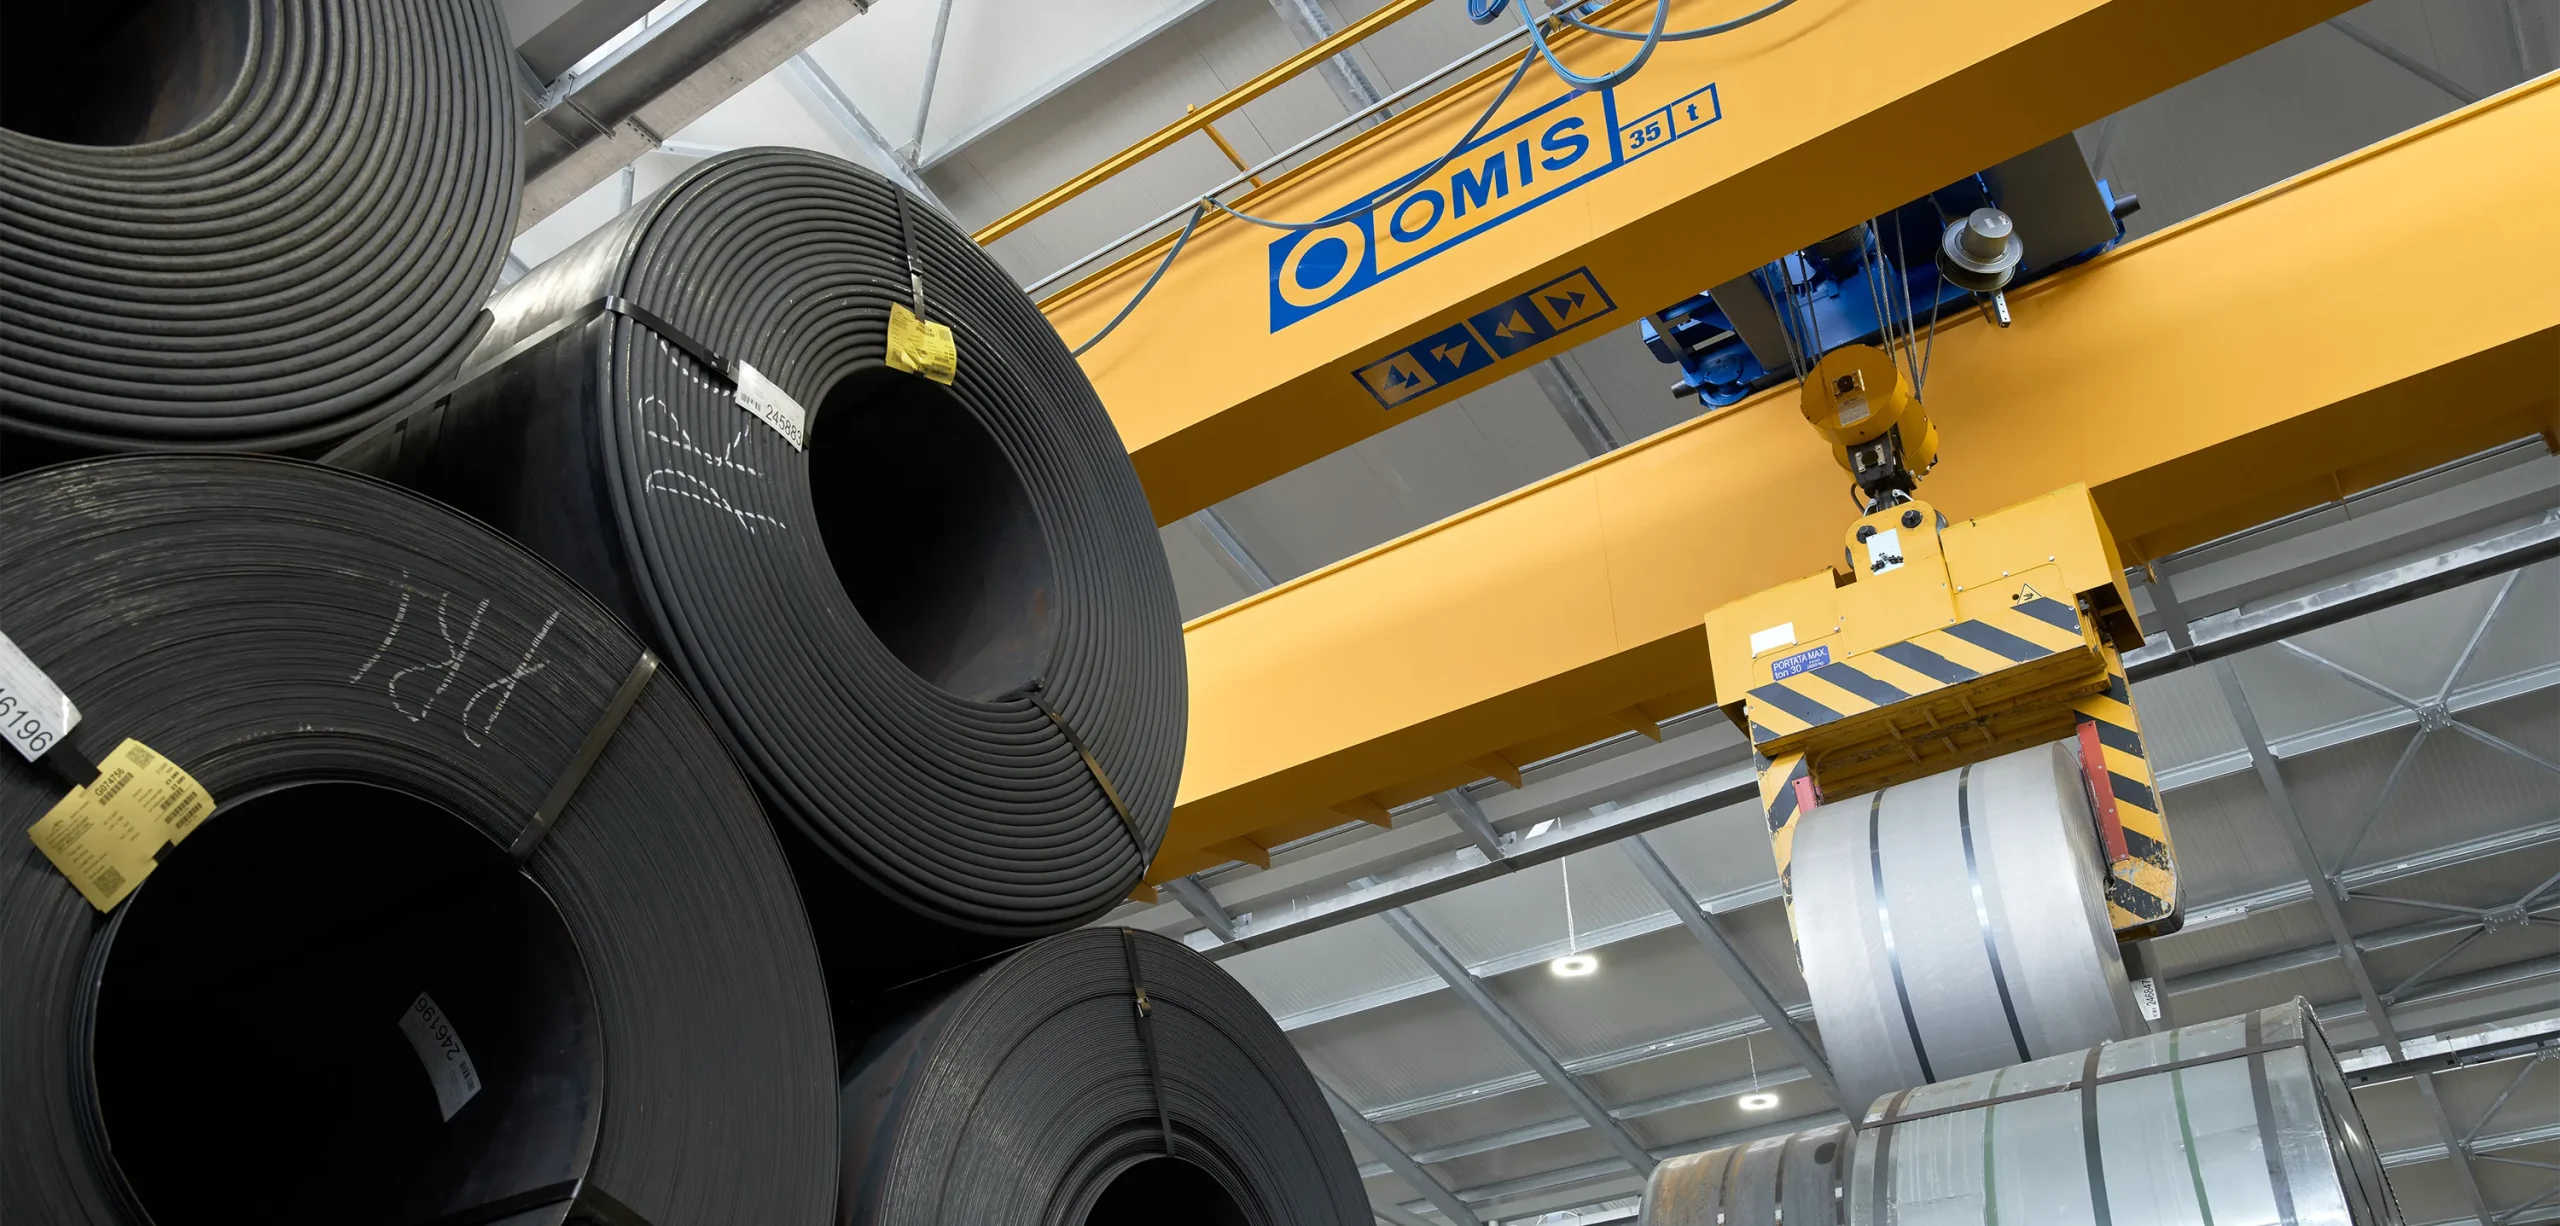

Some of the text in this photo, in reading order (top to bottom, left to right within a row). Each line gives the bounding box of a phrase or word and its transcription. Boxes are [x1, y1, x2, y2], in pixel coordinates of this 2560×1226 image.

[1629, 103, 1699, 150] 35 t
[1389, 116, 1590, 243] OMIS
[765, 404, 803, 446] 245883
[1773, 654, 1807, 671] PORTATA
[1808, 647, 1828, 660] MAX.
[1774, 664, 1802, 679] ton 30
[0, 685, 54, 752] 6196
[95, 767, 125, 797] G074756
[2141, 979, 2156, 1006] 246847
[415, 997, 460, 1061] 246196
